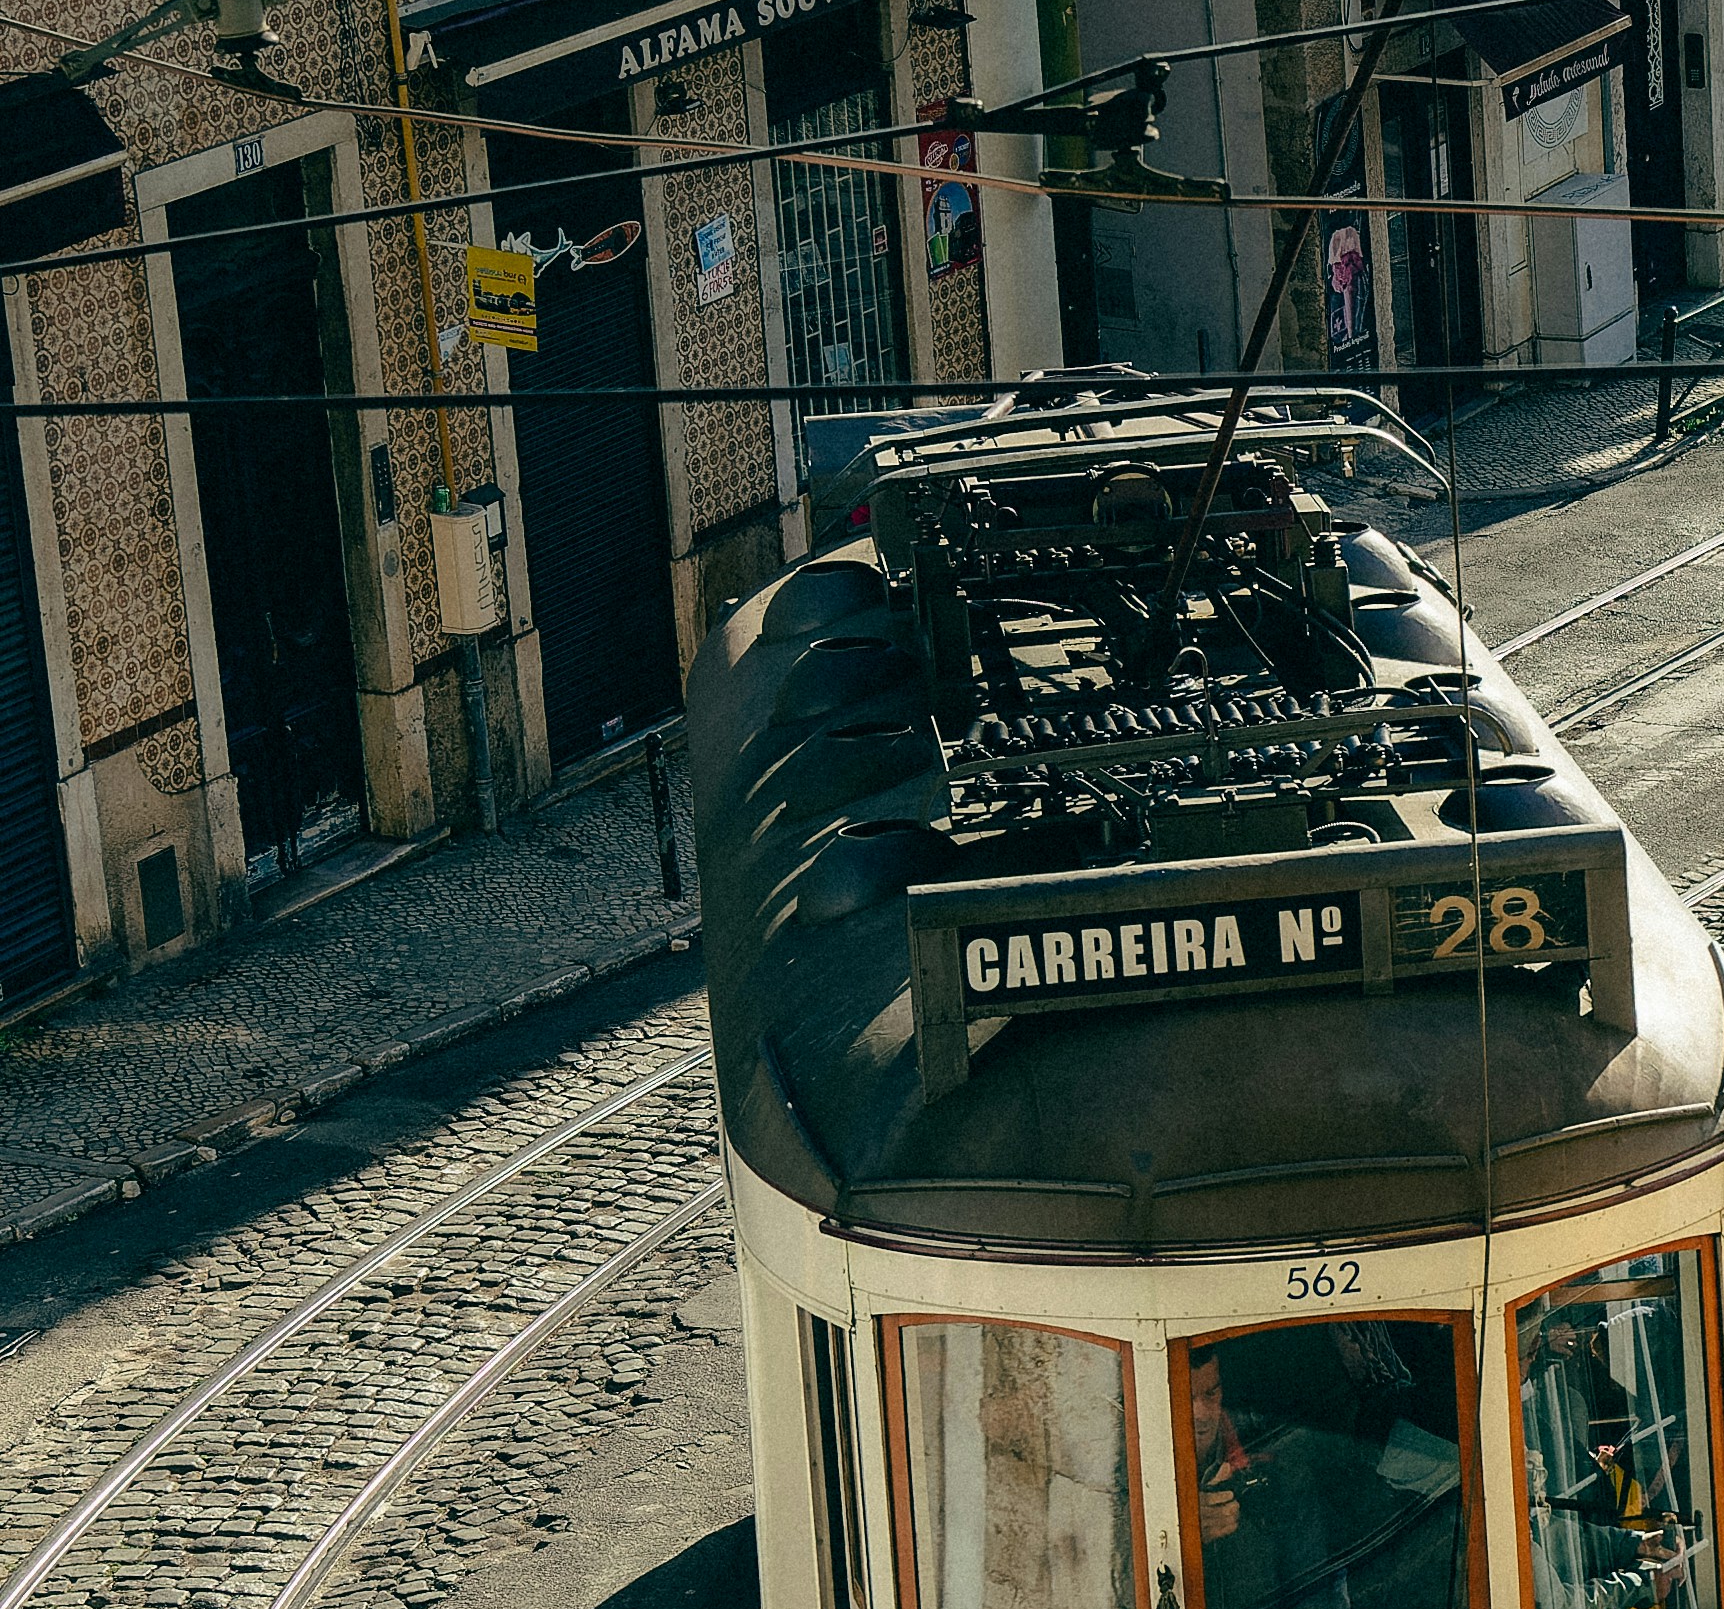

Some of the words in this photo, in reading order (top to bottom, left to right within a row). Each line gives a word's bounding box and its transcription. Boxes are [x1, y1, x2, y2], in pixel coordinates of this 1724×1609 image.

[617, 7, 746, 80] ALFAMA
[237, 142, 261, 172] 130
[966, 915, 1247, 992] CARREIRA
[1278, 906, 1344, 963] Nº
[1428, 887, 1546, 959] 28
[1286, 1260, 1362, 1301] 562
